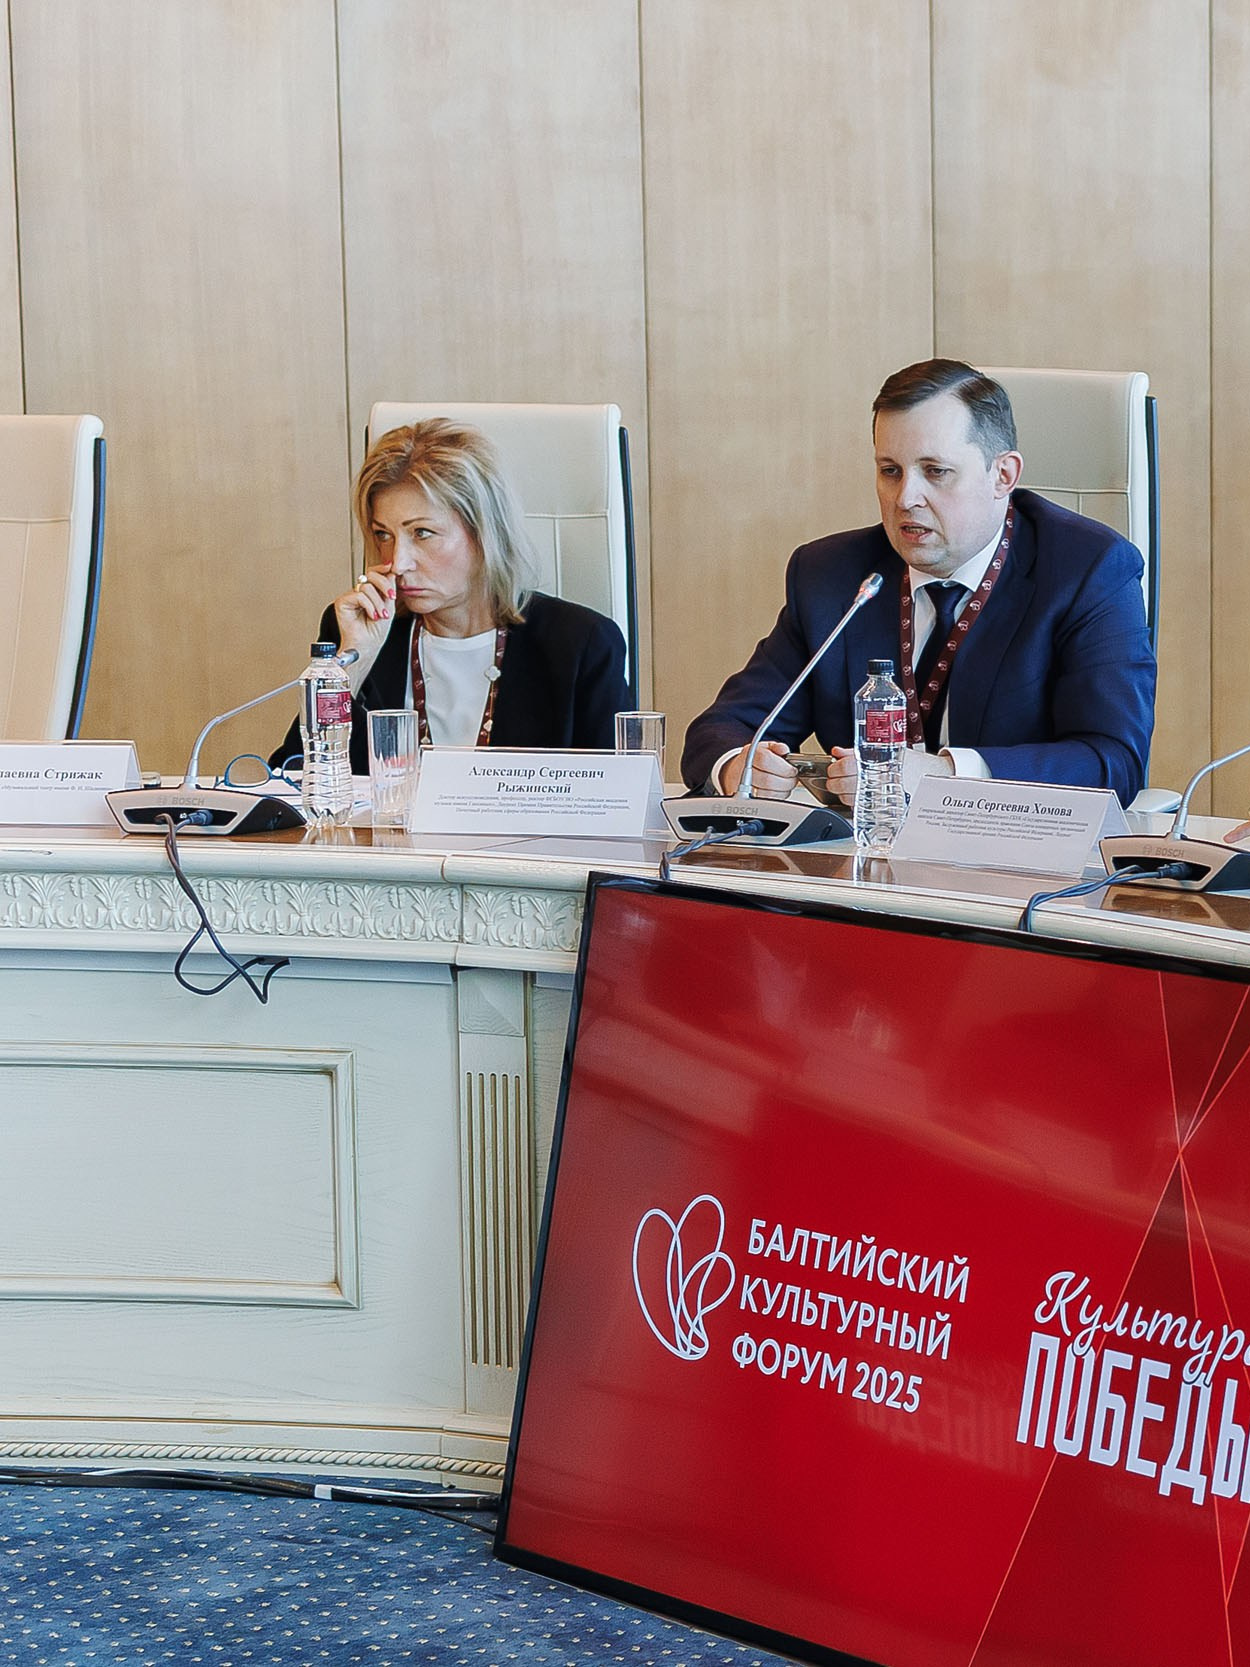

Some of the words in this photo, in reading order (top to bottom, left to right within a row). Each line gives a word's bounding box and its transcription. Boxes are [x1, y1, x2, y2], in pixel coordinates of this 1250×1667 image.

[44, 768, 104, 782] Стрижак
[468, 765, 536, 780] Александр
[539, 767, 605, 780] Сергеевич
[496, 781, 572, 795] Рыжинский
[171, 797, 205, 805] BOSCH
[942, 795, 974, 810] Ольга
[976, 797, 1030, 816] Сергеевна
[1031, 802, 1073, 817] Хомова
[726, 806, 759, 815] BOSCH
[1155, 848, 1184, 857] BOSCH
[748, 1218, 970, 1303] БАЛТИЙСКИЙ
[739, 1274, 952, 1360] КУЛЬТУРНЫЙ
[732, 1332, 848, 1394] ФОРУМ
[851, 1362, 923, 1413] 2025
